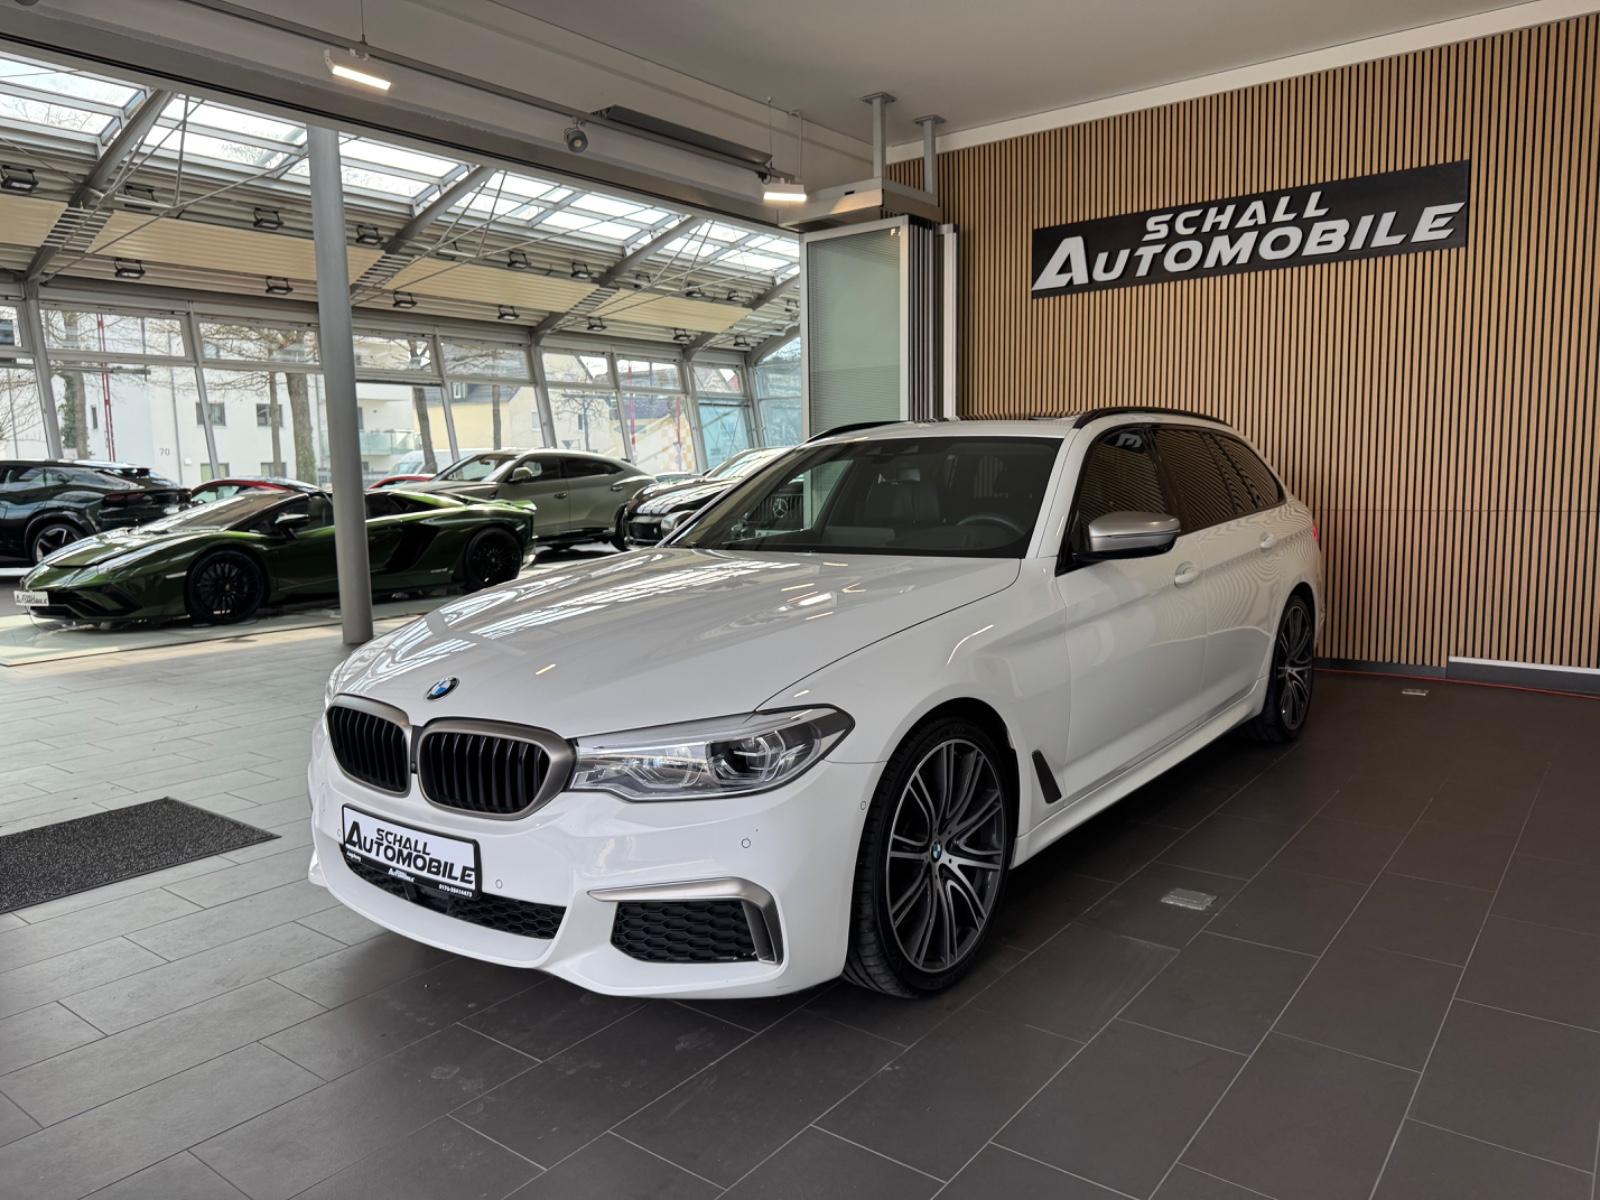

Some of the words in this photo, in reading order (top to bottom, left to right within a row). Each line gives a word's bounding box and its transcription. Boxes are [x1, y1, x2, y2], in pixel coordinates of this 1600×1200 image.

[1142, 191, 1330, 242] SCHALL
[1032, 202, 1466, 292] AUTOMOBILE
[159, 447, 170, 456] 70
[345, 821, 476, 884] AUTOMOBILE
[376, 828, 431, 857] SCHALL
